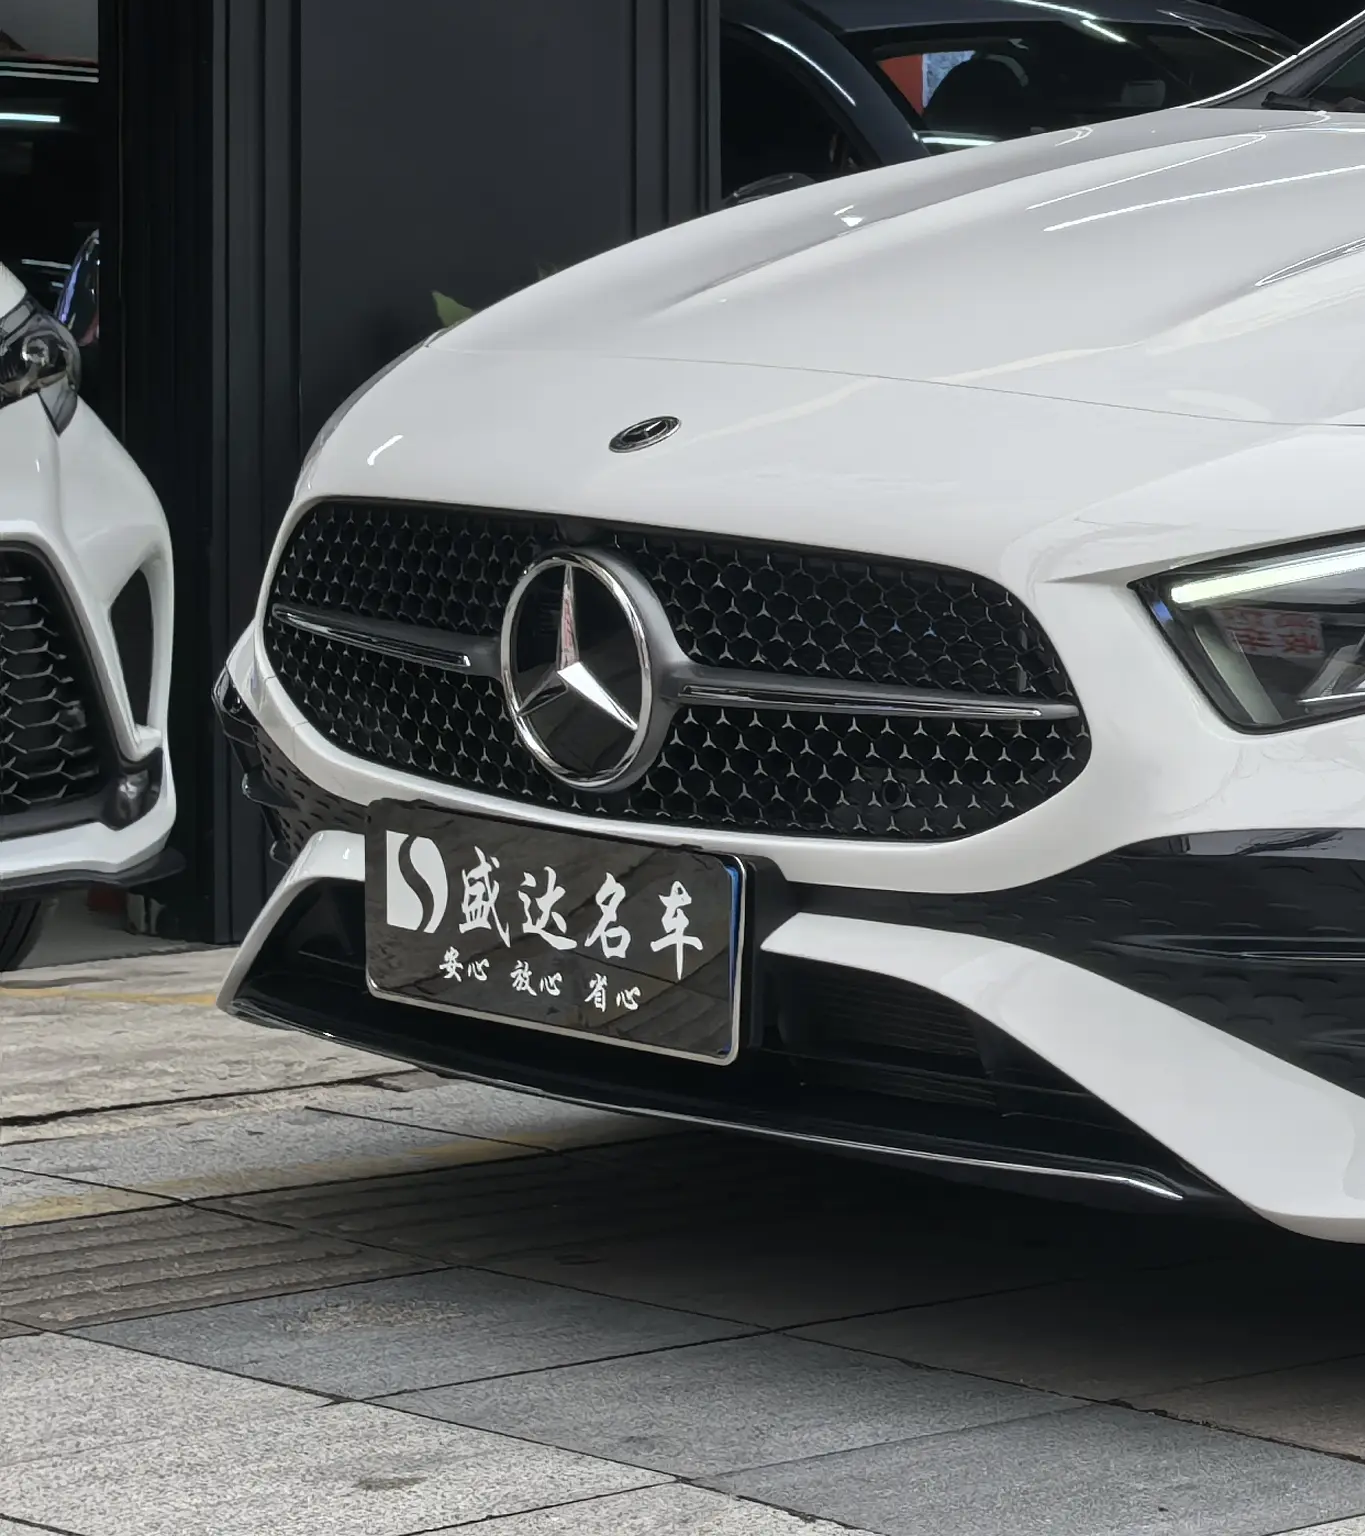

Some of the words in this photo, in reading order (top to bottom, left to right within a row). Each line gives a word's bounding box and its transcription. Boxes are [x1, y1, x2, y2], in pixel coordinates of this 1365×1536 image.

[458, 845, 705, 982] 盛达名车
[439, 946, 490, 982] 安心
[510, 960, 564, 997] 放心
[584, 972, 642, 1013] 省心
